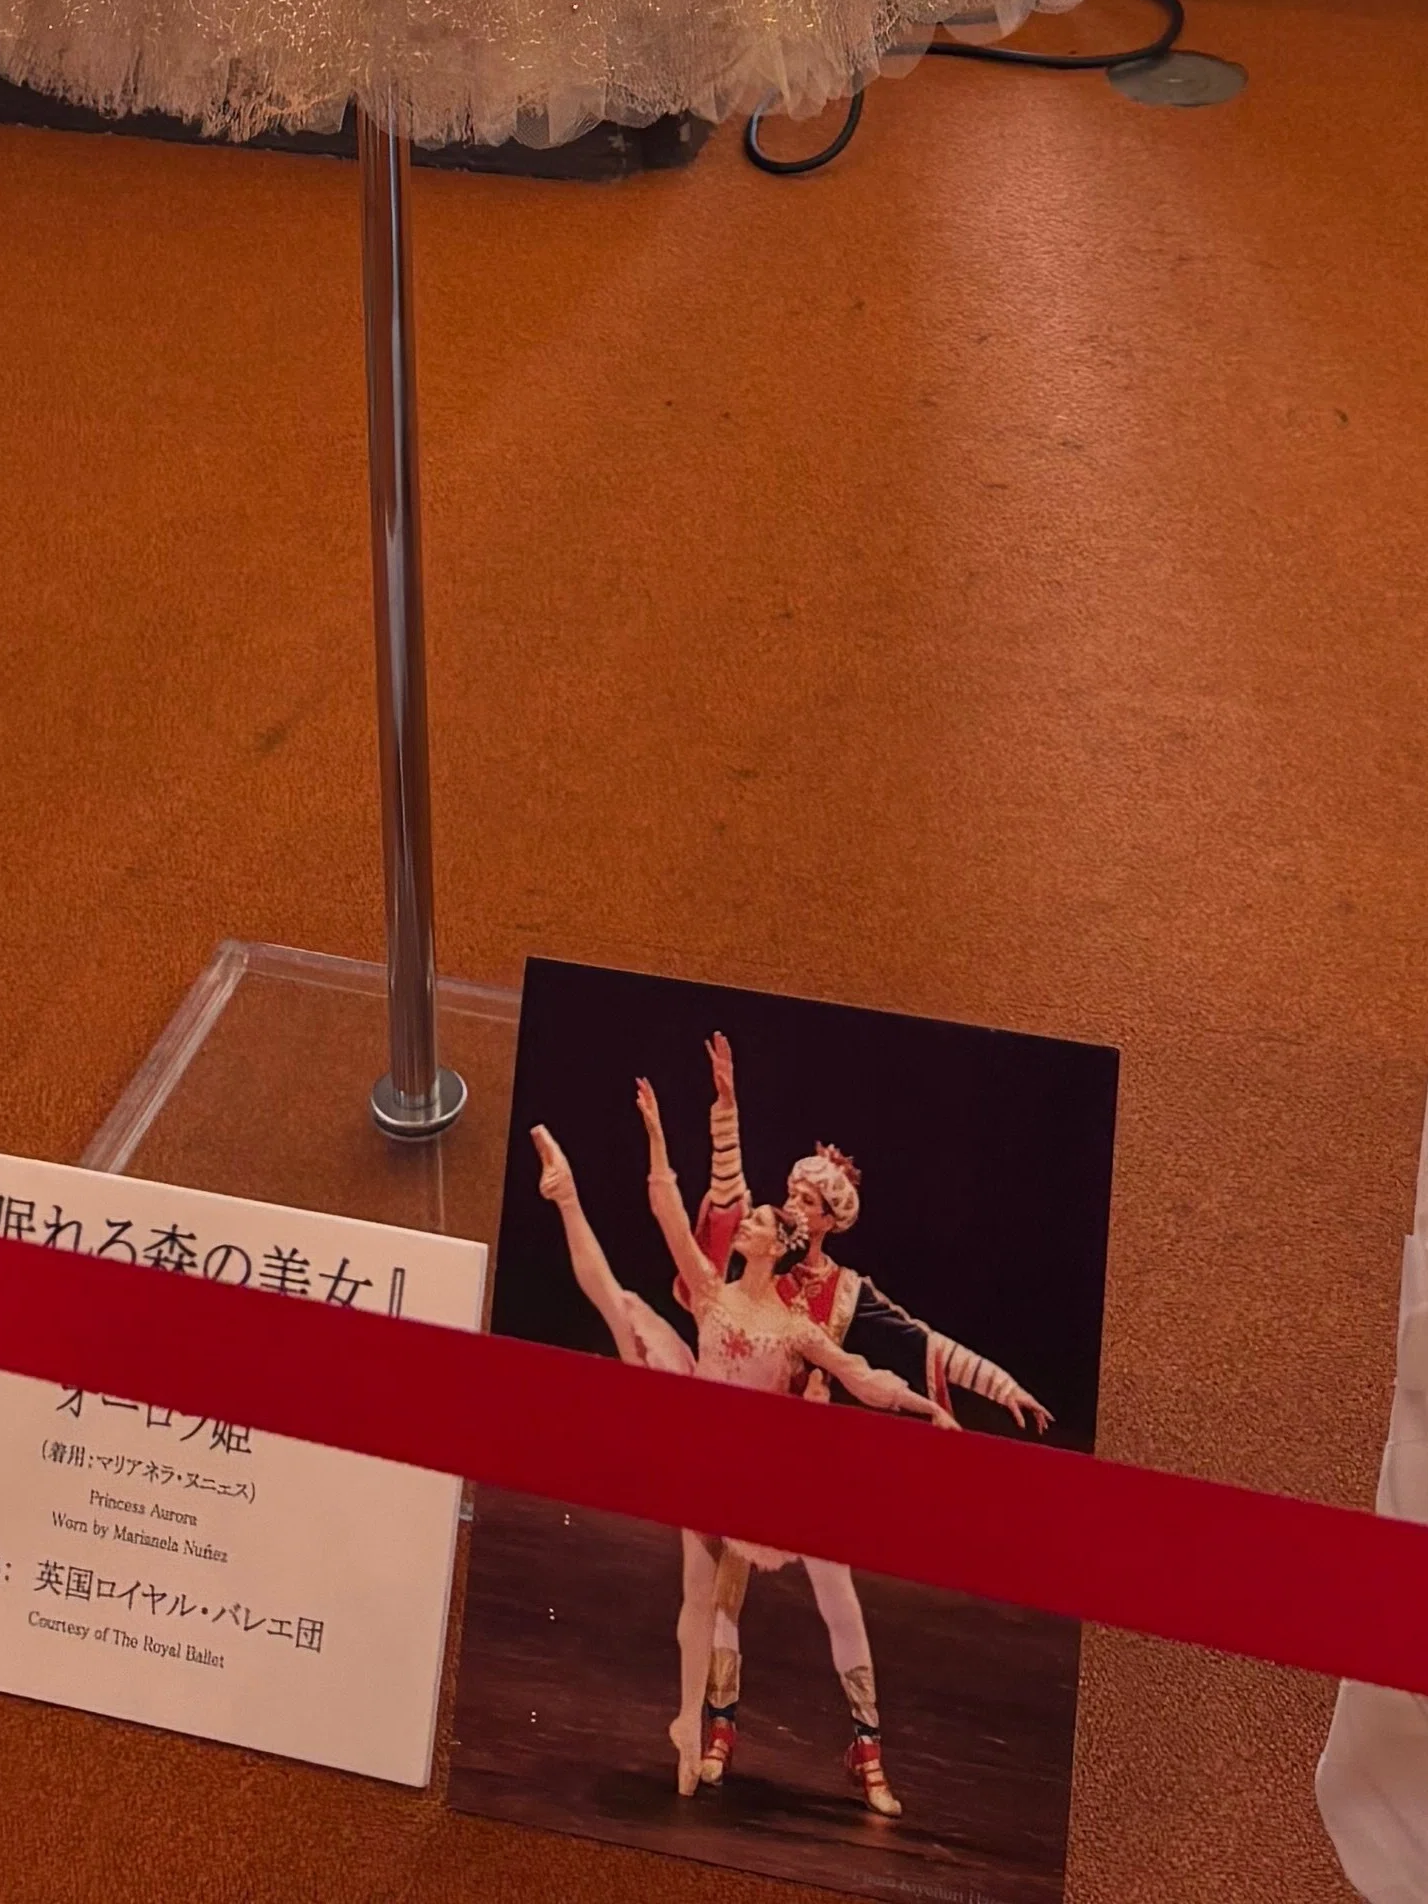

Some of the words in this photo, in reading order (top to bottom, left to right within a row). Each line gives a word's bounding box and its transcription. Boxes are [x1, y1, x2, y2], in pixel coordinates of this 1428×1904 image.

[52, 1511, 88, 1533] Worn
[93, 1520, 109, 1539] by
[113, 1524, 179, 1553] Marianela
[90, 1489, 145, 1515] Princess
[150, 1503, 198, 1527] Aurora
[33, 1559, 325, 1654] 英国ロイヤル・バレエ団
[28, 1610, 90, 1641] Courtesy
[94, 1626, 112, 1642] of
[113, 1628, 139, 1650] The
[143, 1634, 181, 1660] Royal
[186, 1644, 225, 1669] Ballet
